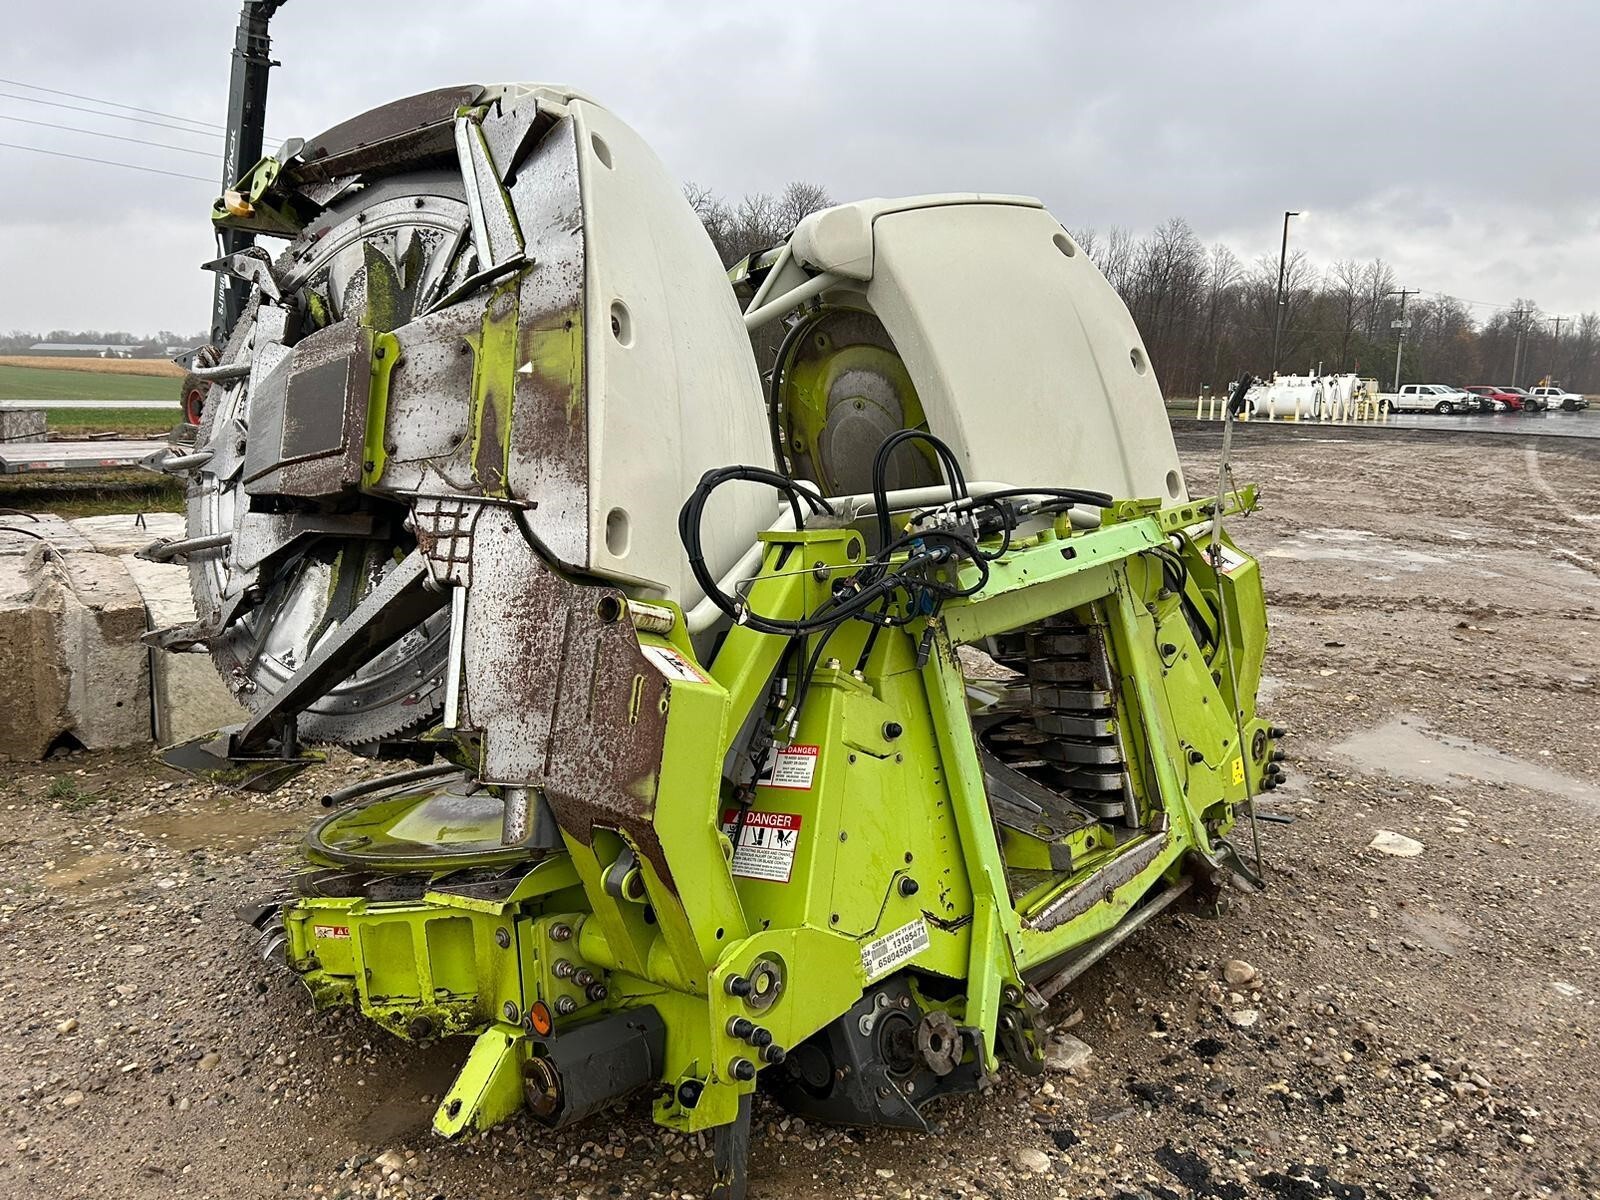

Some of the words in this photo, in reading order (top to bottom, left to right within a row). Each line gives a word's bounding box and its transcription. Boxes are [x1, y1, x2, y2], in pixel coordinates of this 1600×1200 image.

[226, 128, 236, 188] KYJACK
[788, 746, 817, 754] DANGER
[746, 812, 792, 827] DANGER
[893, 926, 925, 948] 13195471
[878, 944, 912, 968] 65804508
